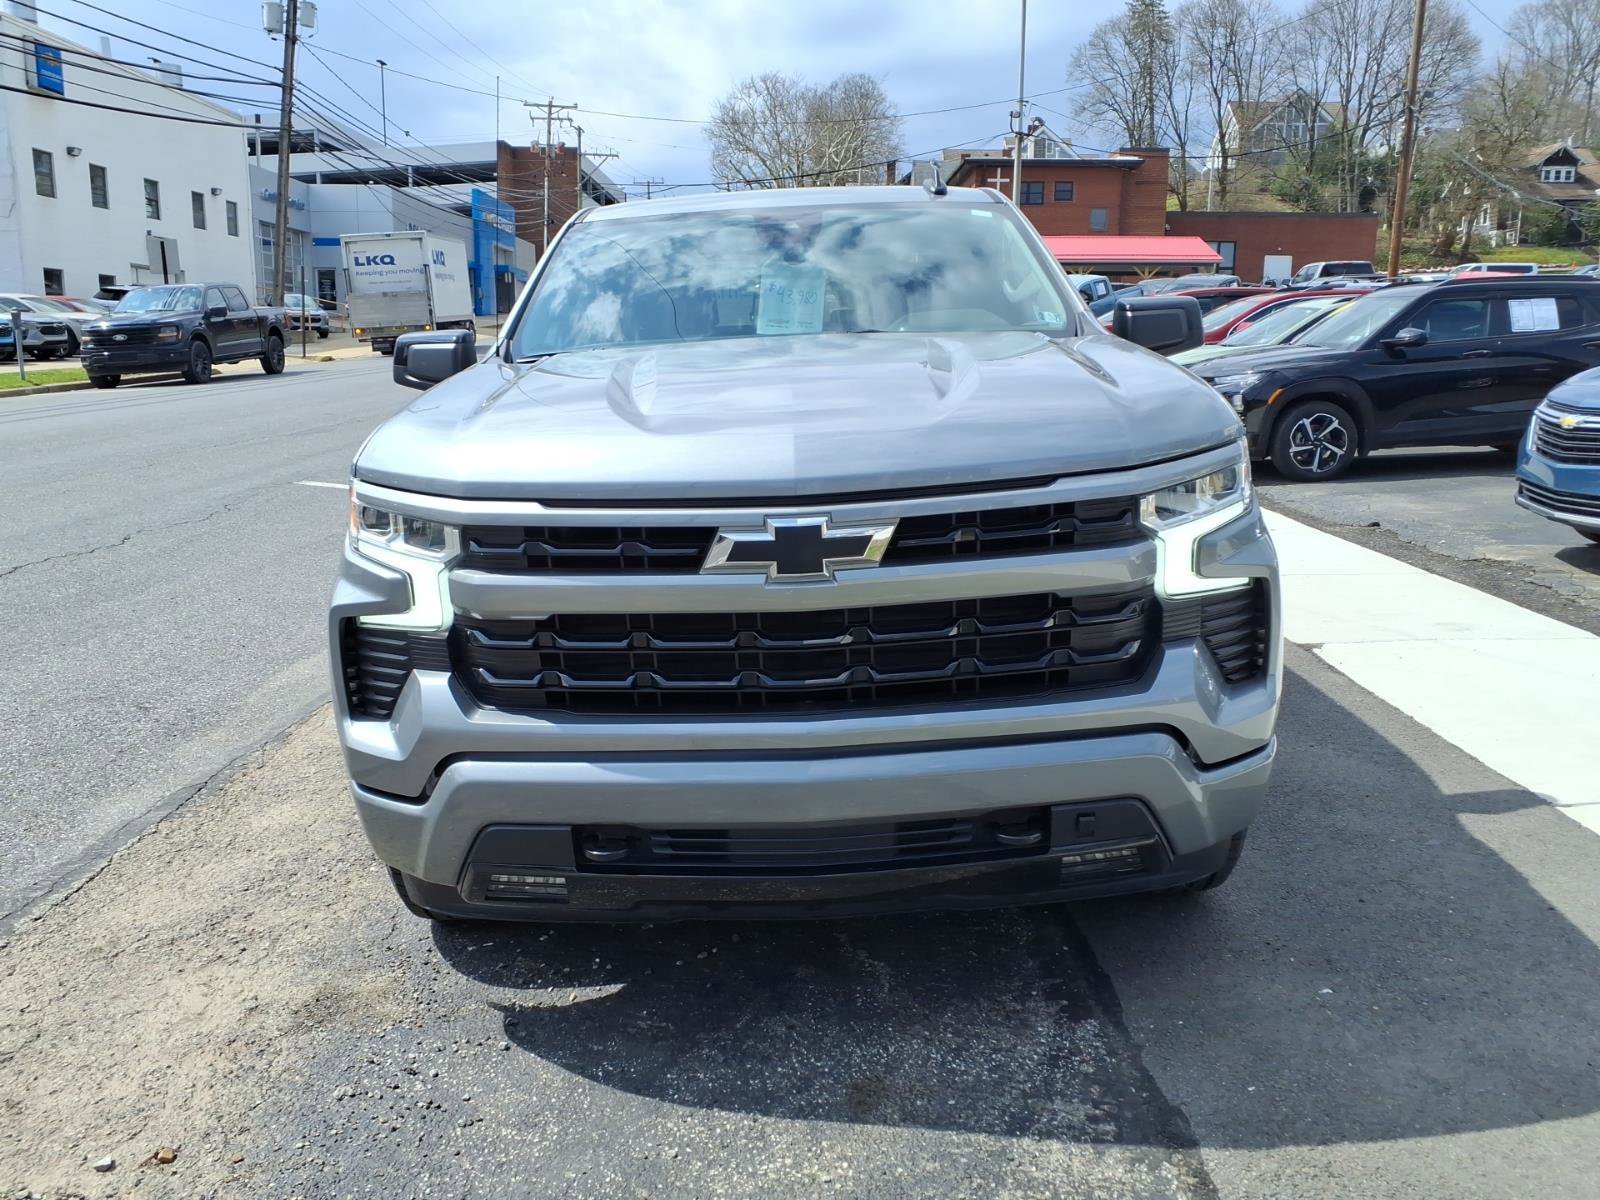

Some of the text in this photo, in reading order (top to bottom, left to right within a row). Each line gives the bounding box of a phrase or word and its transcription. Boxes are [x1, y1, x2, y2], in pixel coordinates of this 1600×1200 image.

[354, 254, 396, 267] LKQ
[432, 247, 446, 266] LKQ
[384, 268, 399, 277] you
[399, 267, 424, 275] moving
